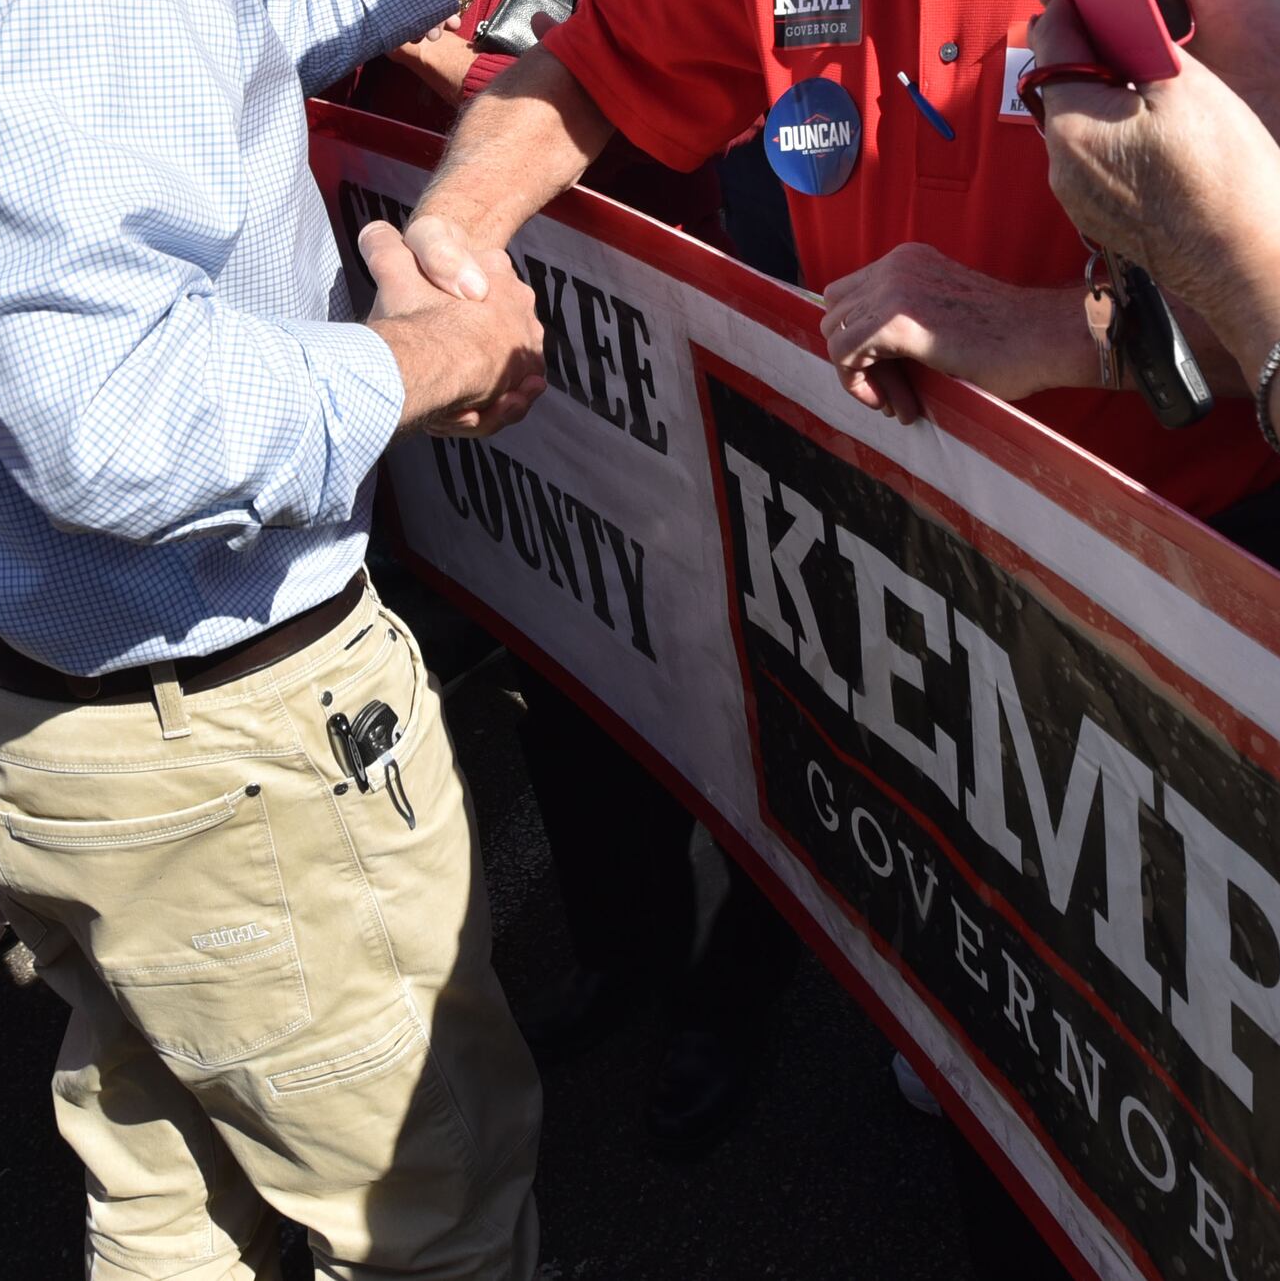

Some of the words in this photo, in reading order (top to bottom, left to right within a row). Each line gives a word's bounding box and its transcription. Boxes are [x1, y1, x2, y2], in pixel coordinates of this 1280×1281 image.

[785, 22, 848, 37] GOVERNOR
[779, 121, 851, 151] DUNCAN
[430, 436, 658, 663] COUNTY
[805, 759, 1237, 1281] GOVERNOR
